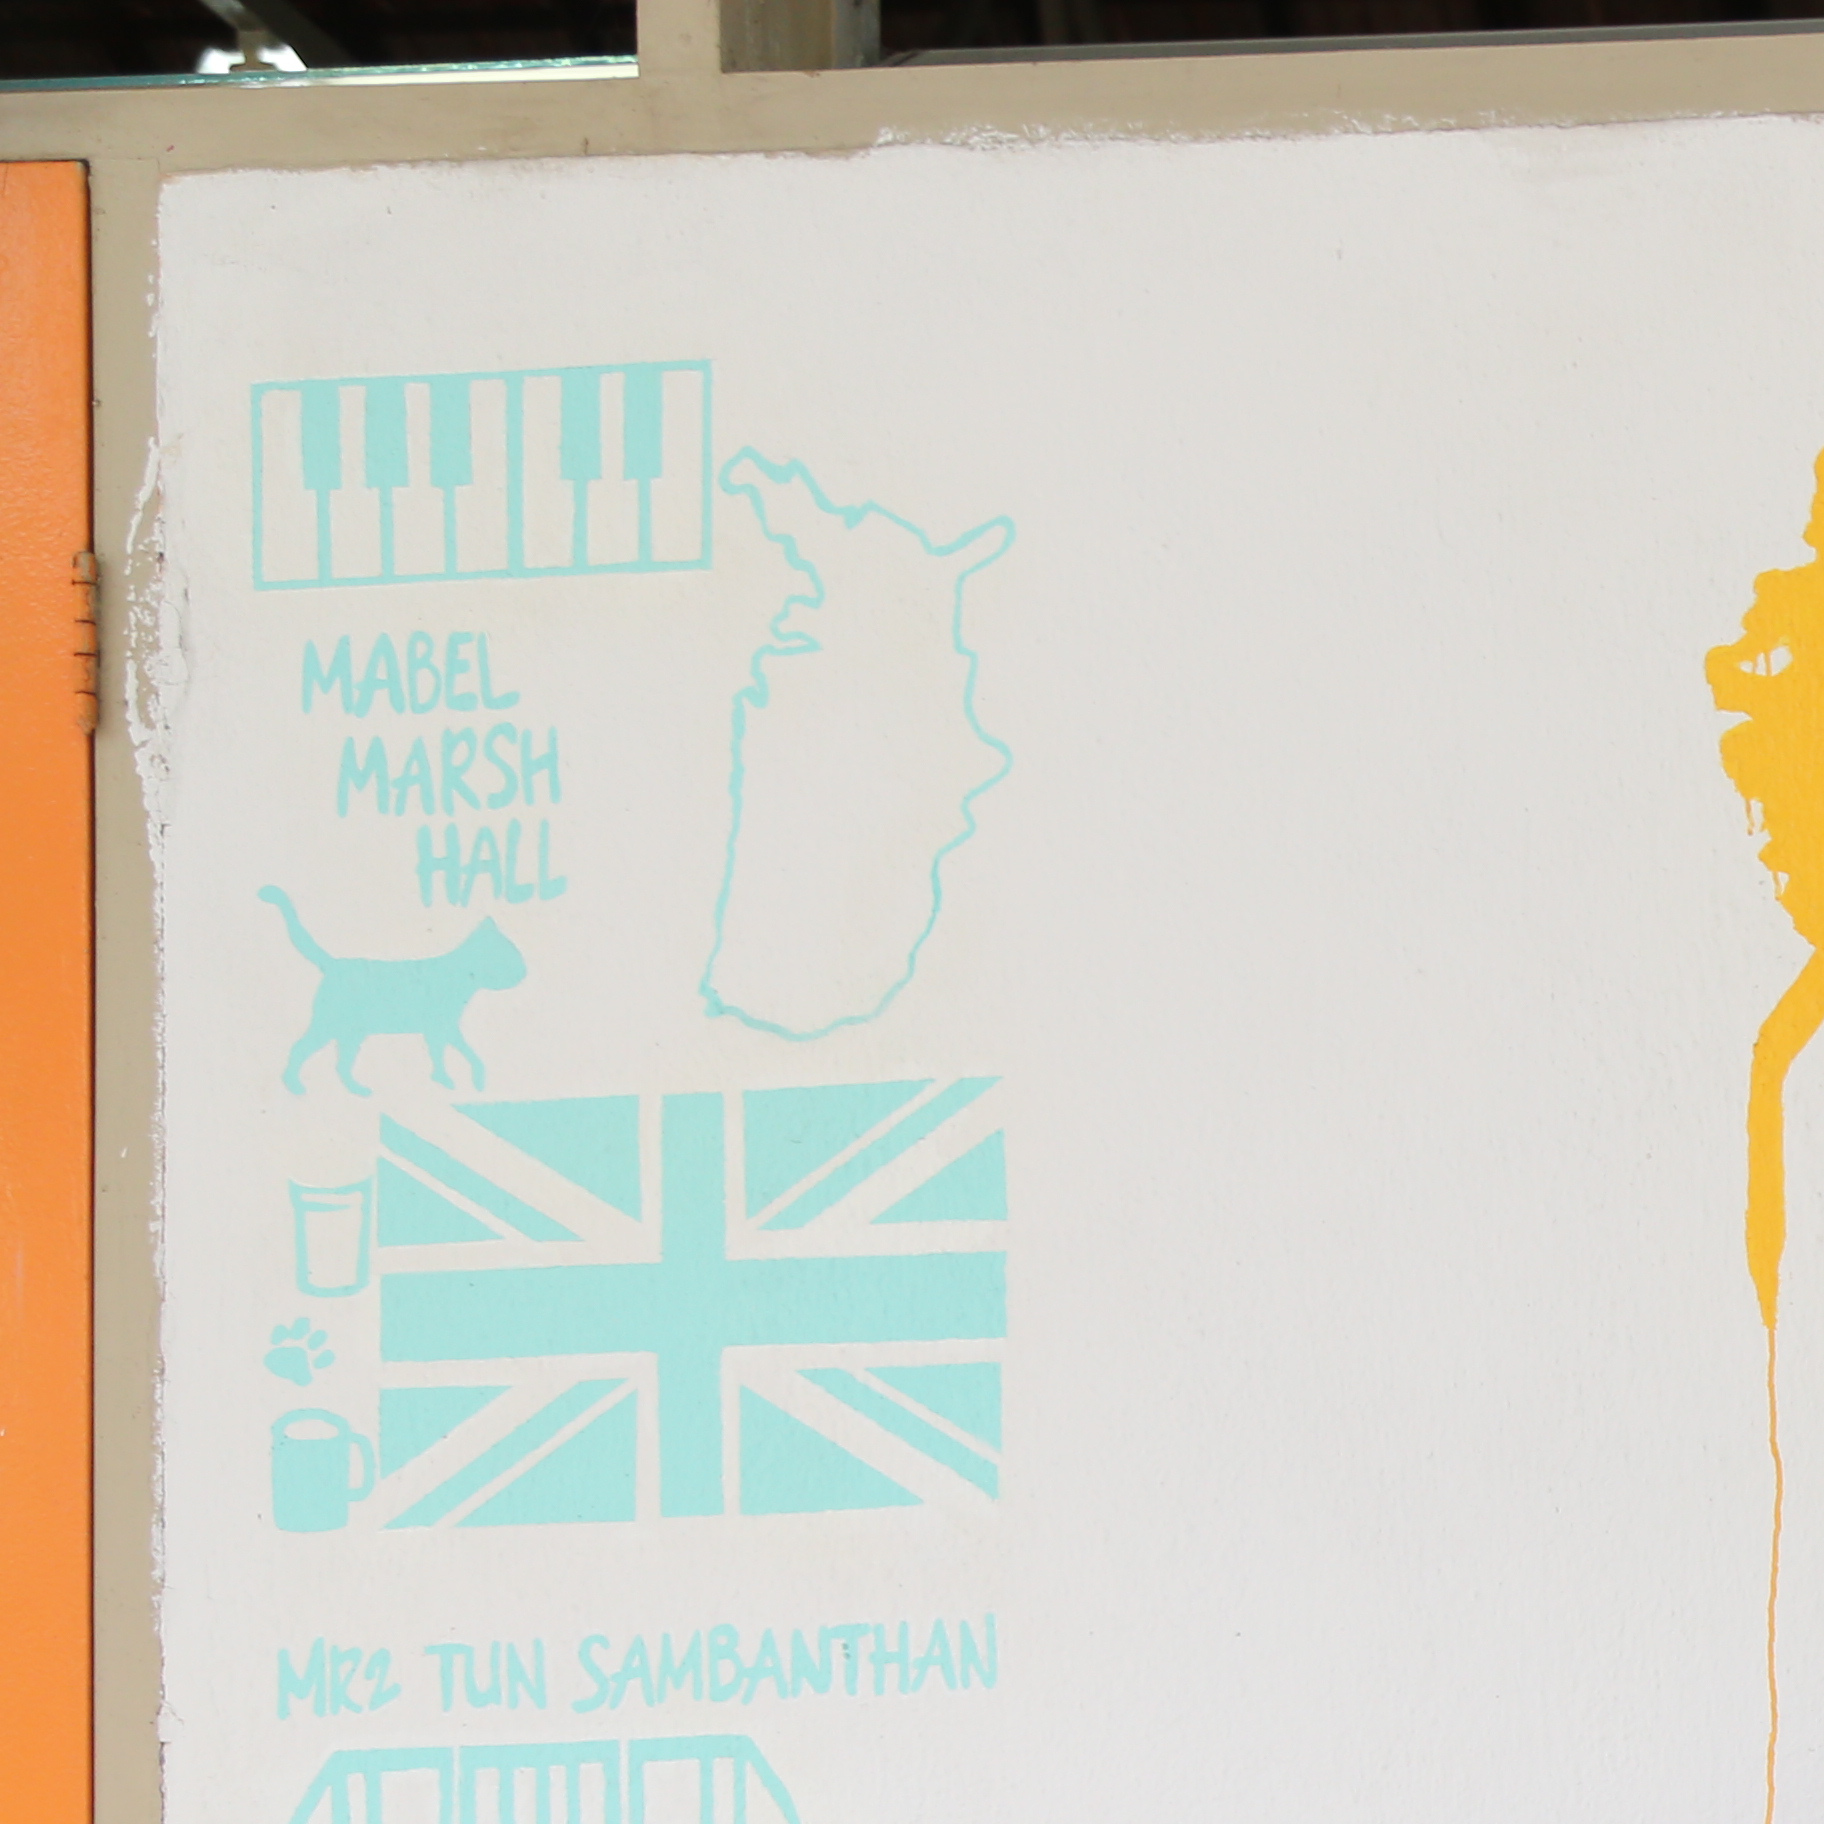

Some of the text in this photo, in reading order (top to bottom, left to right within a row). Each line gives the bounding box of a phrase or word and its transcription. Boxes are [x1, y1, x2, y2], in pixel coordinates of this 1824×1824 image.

[301, 630, 521, 718] MABEL
[336, 722, 562, 818] MARSH
[415, 817, 568, 908] HALL
[276, 1612, 999, 1720] MR2 TUN SAMBANTHAN
